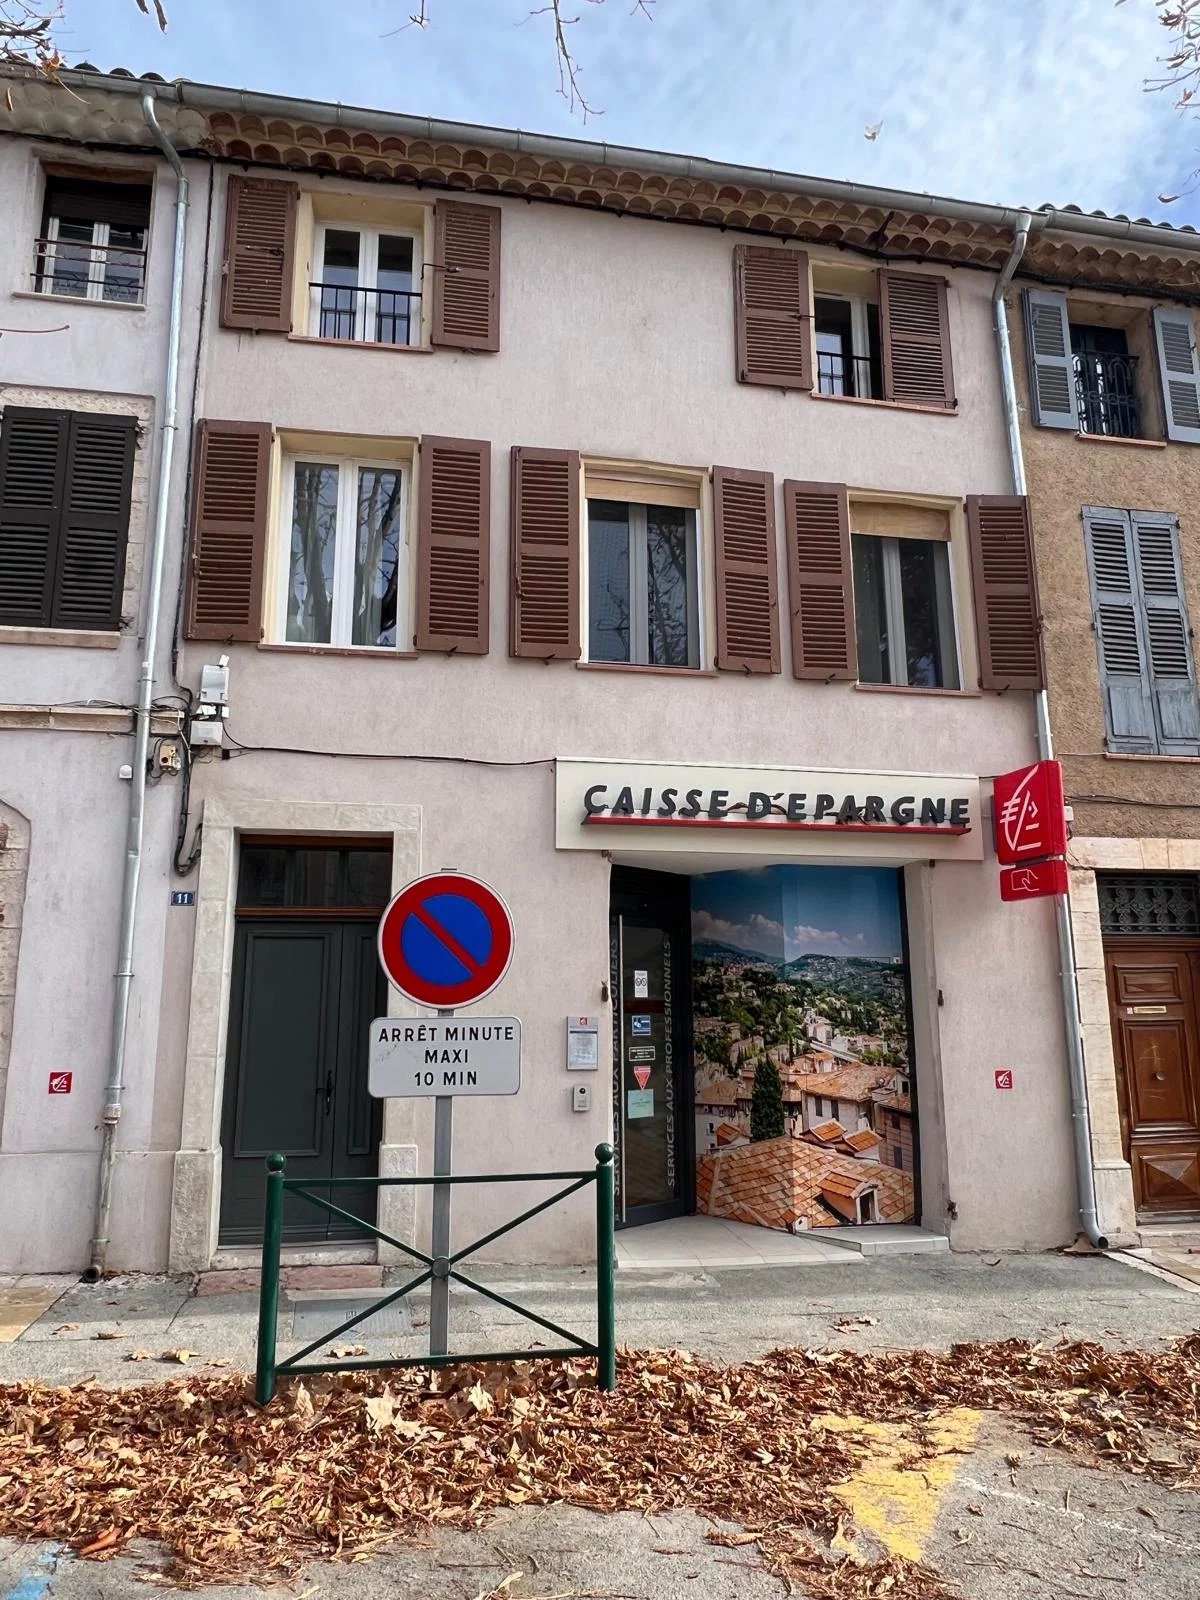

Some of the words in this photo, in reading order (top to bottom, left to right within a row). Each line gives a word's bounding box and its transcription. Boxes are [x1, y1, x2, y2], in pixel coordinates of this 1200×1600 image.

[583, 784, 730, 819] CAISSE
[177, 894, 187, 903] 11
[663, 941, 673, 1073] PROFESSIONNELS
[378, 1025, 438, 1042] ARRÊT
[445, 1026, 514, 1041] MINUTE
[424, 1049, 469, 1064] MAXI
[414, 1072, 434, 1087] 10
[443, 1071, 477, 1086] MIN
[665, 1078, 674, 1111] AUX
[666, 1113, 675, 1187] SERVICES
